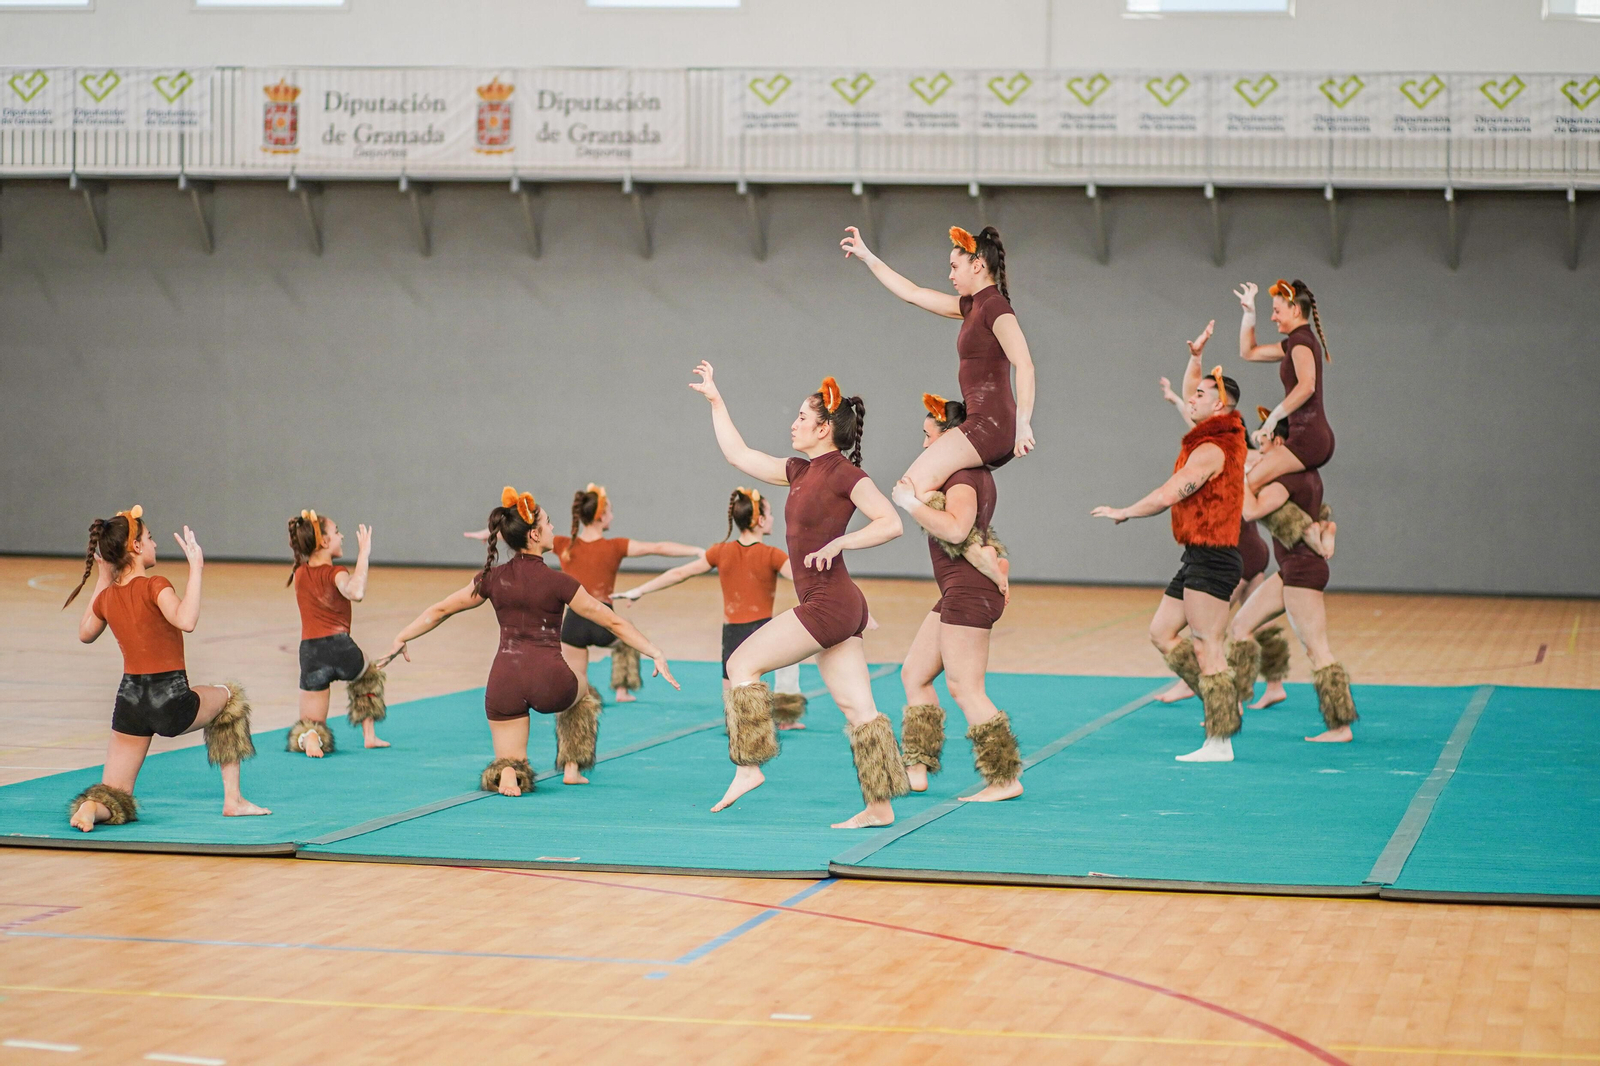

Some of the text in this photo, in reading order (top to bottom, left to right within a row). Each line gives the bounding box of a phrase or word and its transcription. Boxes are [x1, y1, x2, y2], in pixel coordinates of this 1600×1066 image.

[324, 90, 446, 117] Diputación
[537, 89, 661, 117] Diputación
[322, 123, 445, 145] de Granada
[536, 122, 661, 144] de Granada
